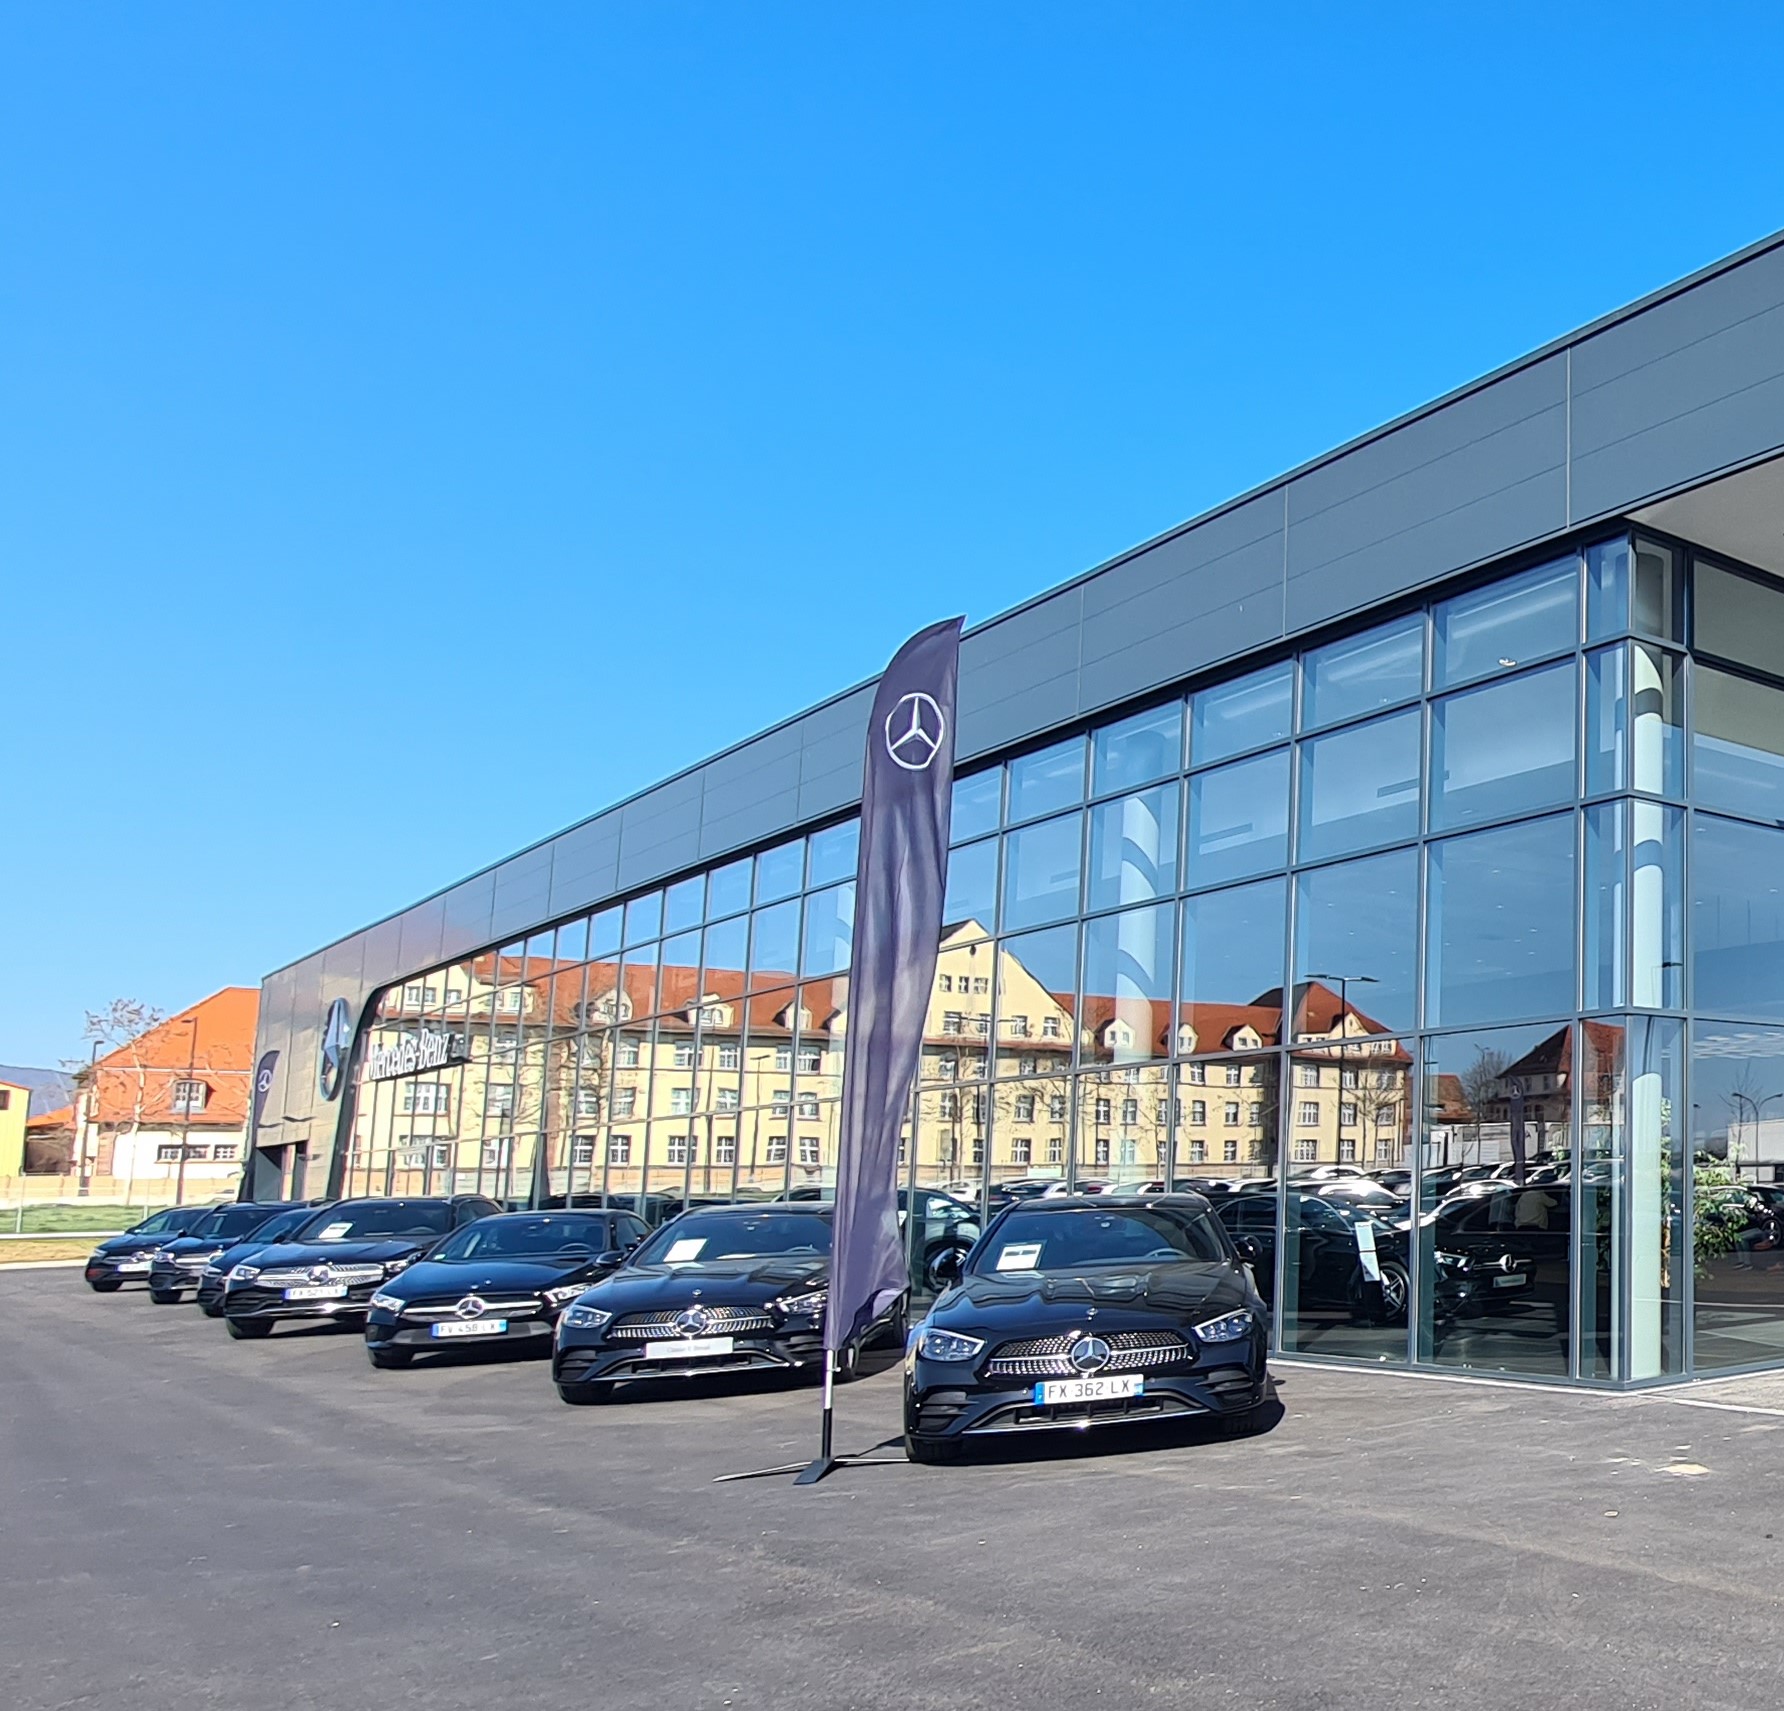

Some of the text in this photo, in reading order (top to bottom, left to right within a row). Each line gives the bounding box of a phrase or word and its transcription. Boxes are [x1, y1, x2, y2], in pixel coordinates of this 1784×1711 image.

[369, 1027, 450, 1081] Mercedes-Benz
[1048, 1379, 1130, 1399] FX 362 LX
